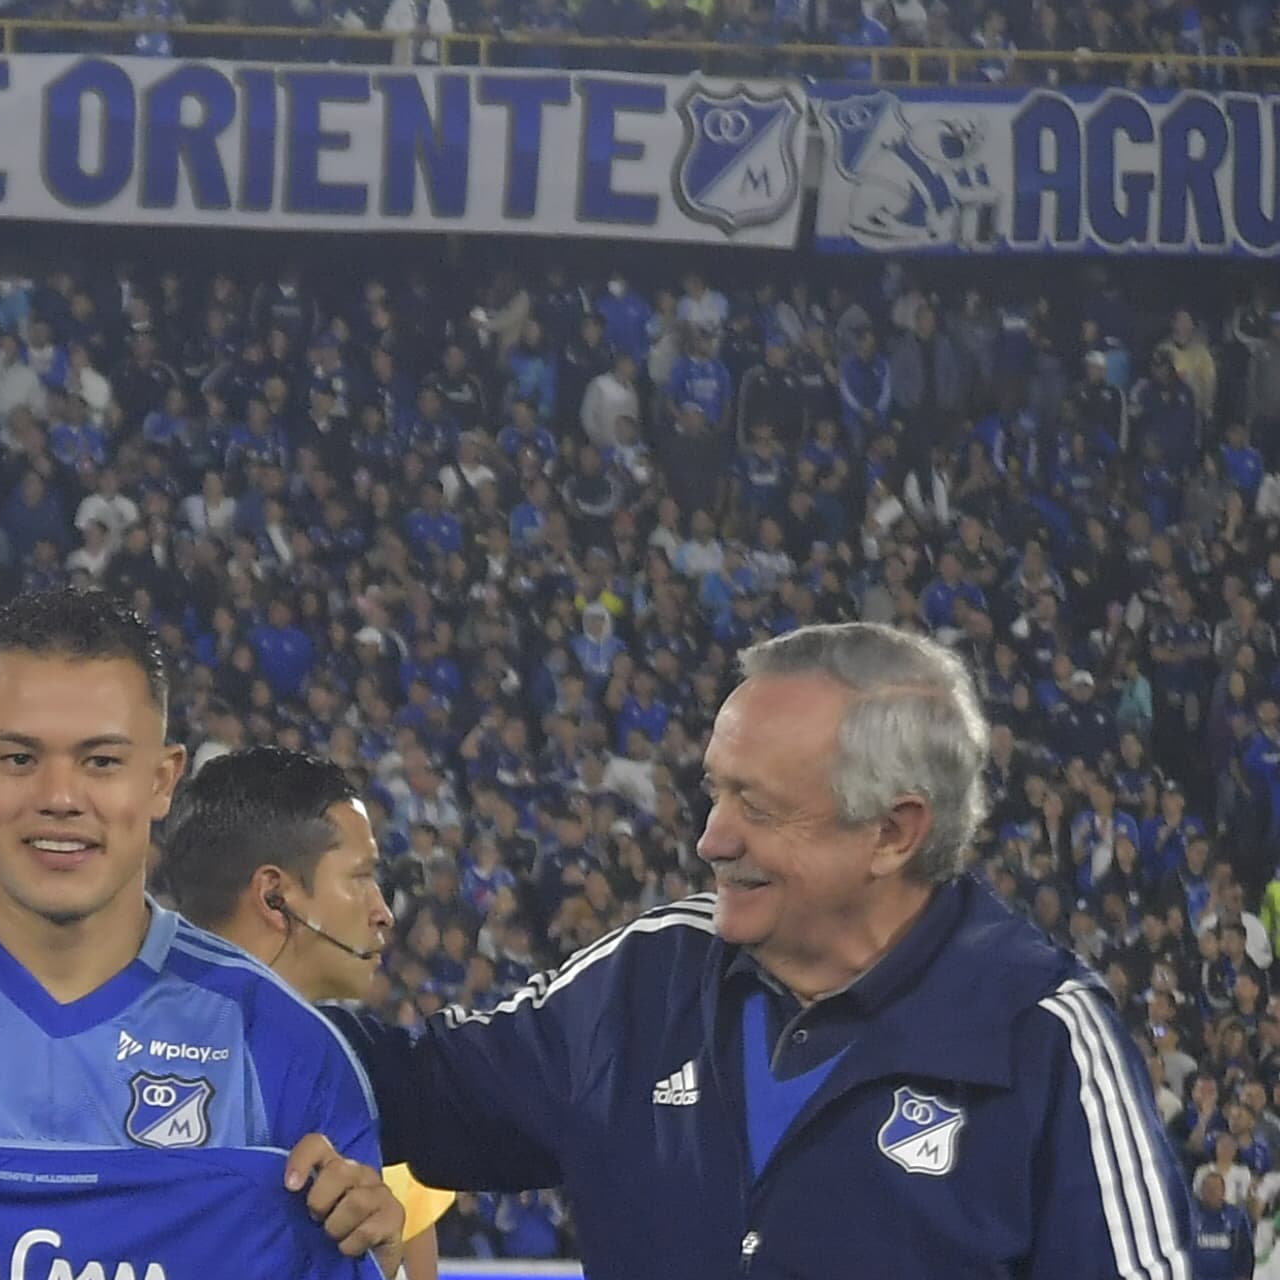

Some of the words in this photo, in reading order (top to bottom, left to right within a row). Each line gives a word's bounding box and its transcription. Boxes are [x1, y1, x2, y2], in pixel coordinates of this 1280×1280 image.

[41, 57, 666, 225] ORIENTE
[1010, 91, 1280, 250] AGRU
[149, 1039, 229, 1062] Wplay.co
[168, 1117, 193, 1139] M
[917, 1140, 941, 1164] M
